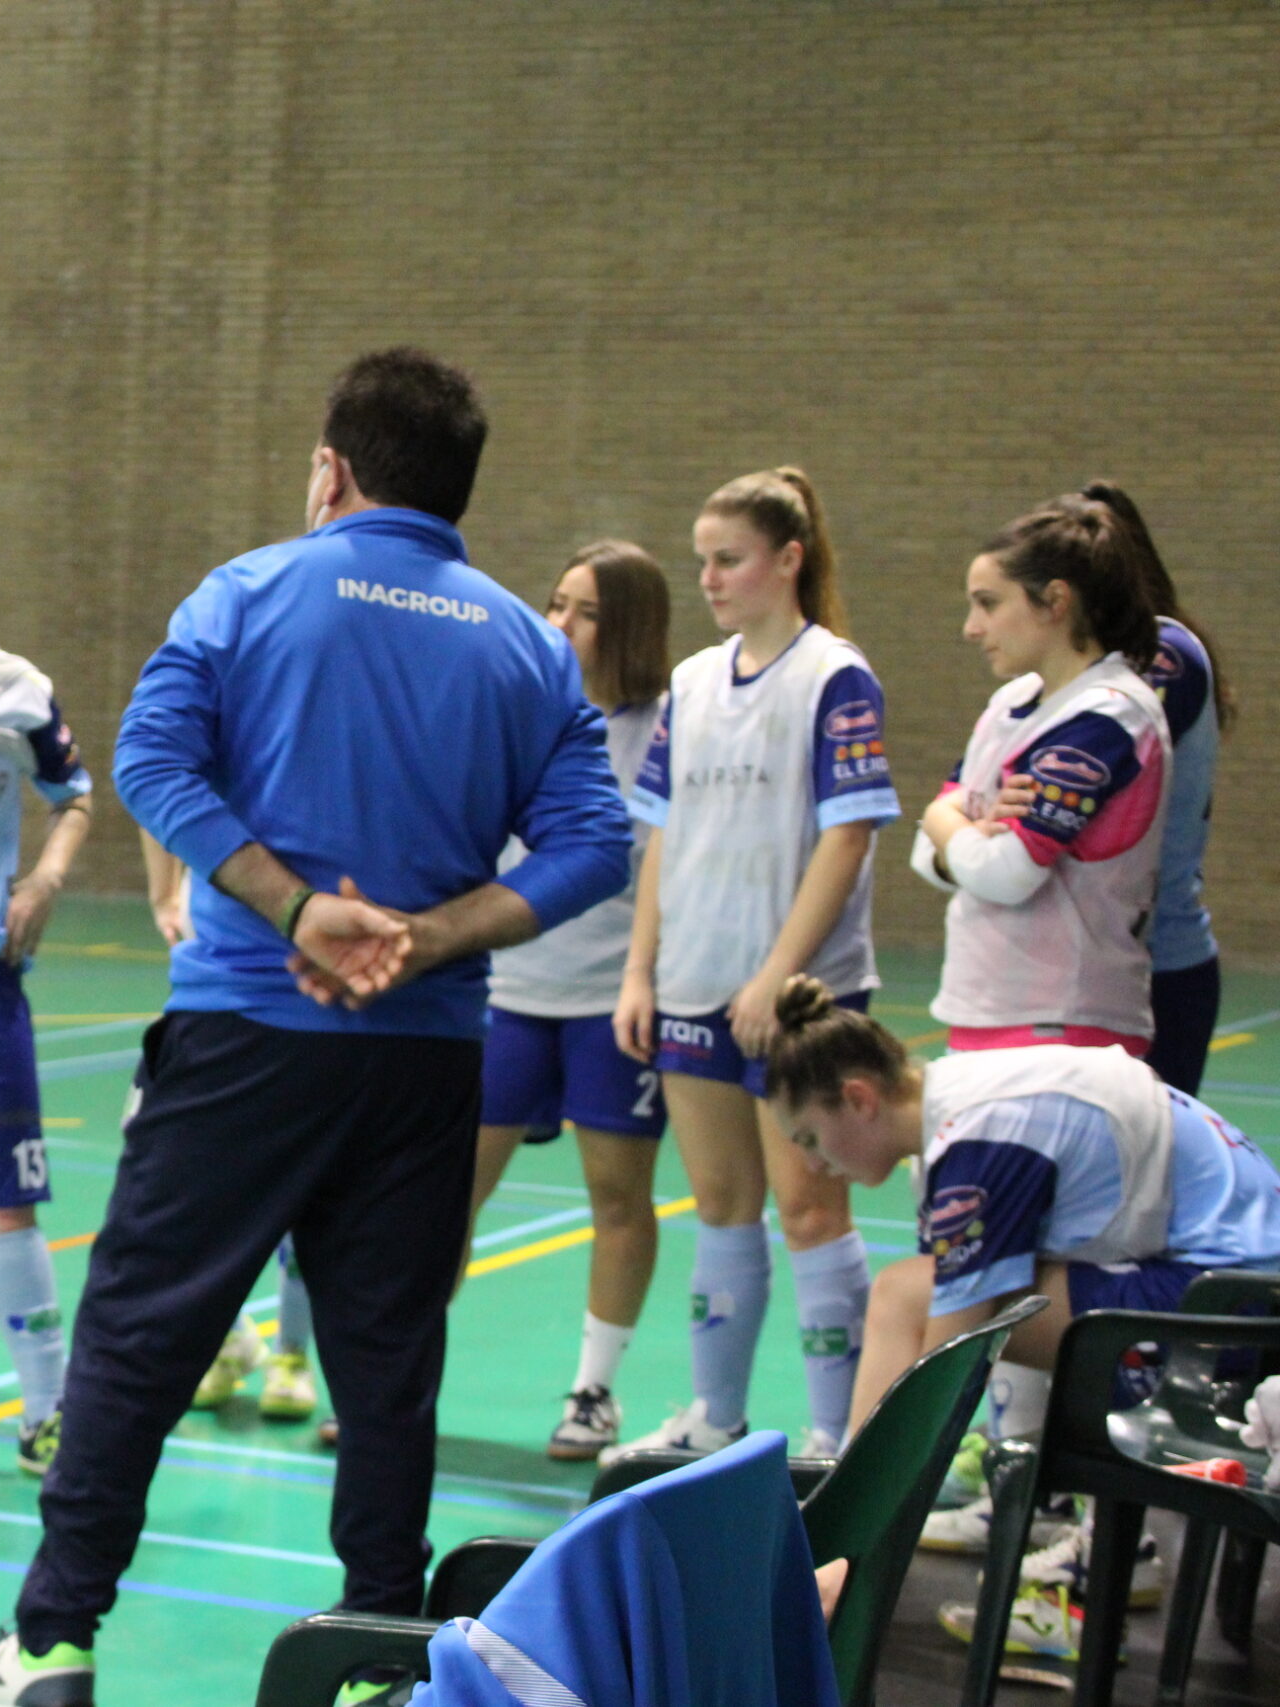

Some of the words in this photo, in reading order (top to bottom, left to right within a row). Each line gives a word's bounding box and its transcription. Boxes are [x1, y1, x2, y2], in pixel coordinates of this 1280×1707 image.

[336, 577, 490, 625] INAGROUP
[631, 1070, 658, 1117] 2
[11, 1139, 47, 1190] 13
